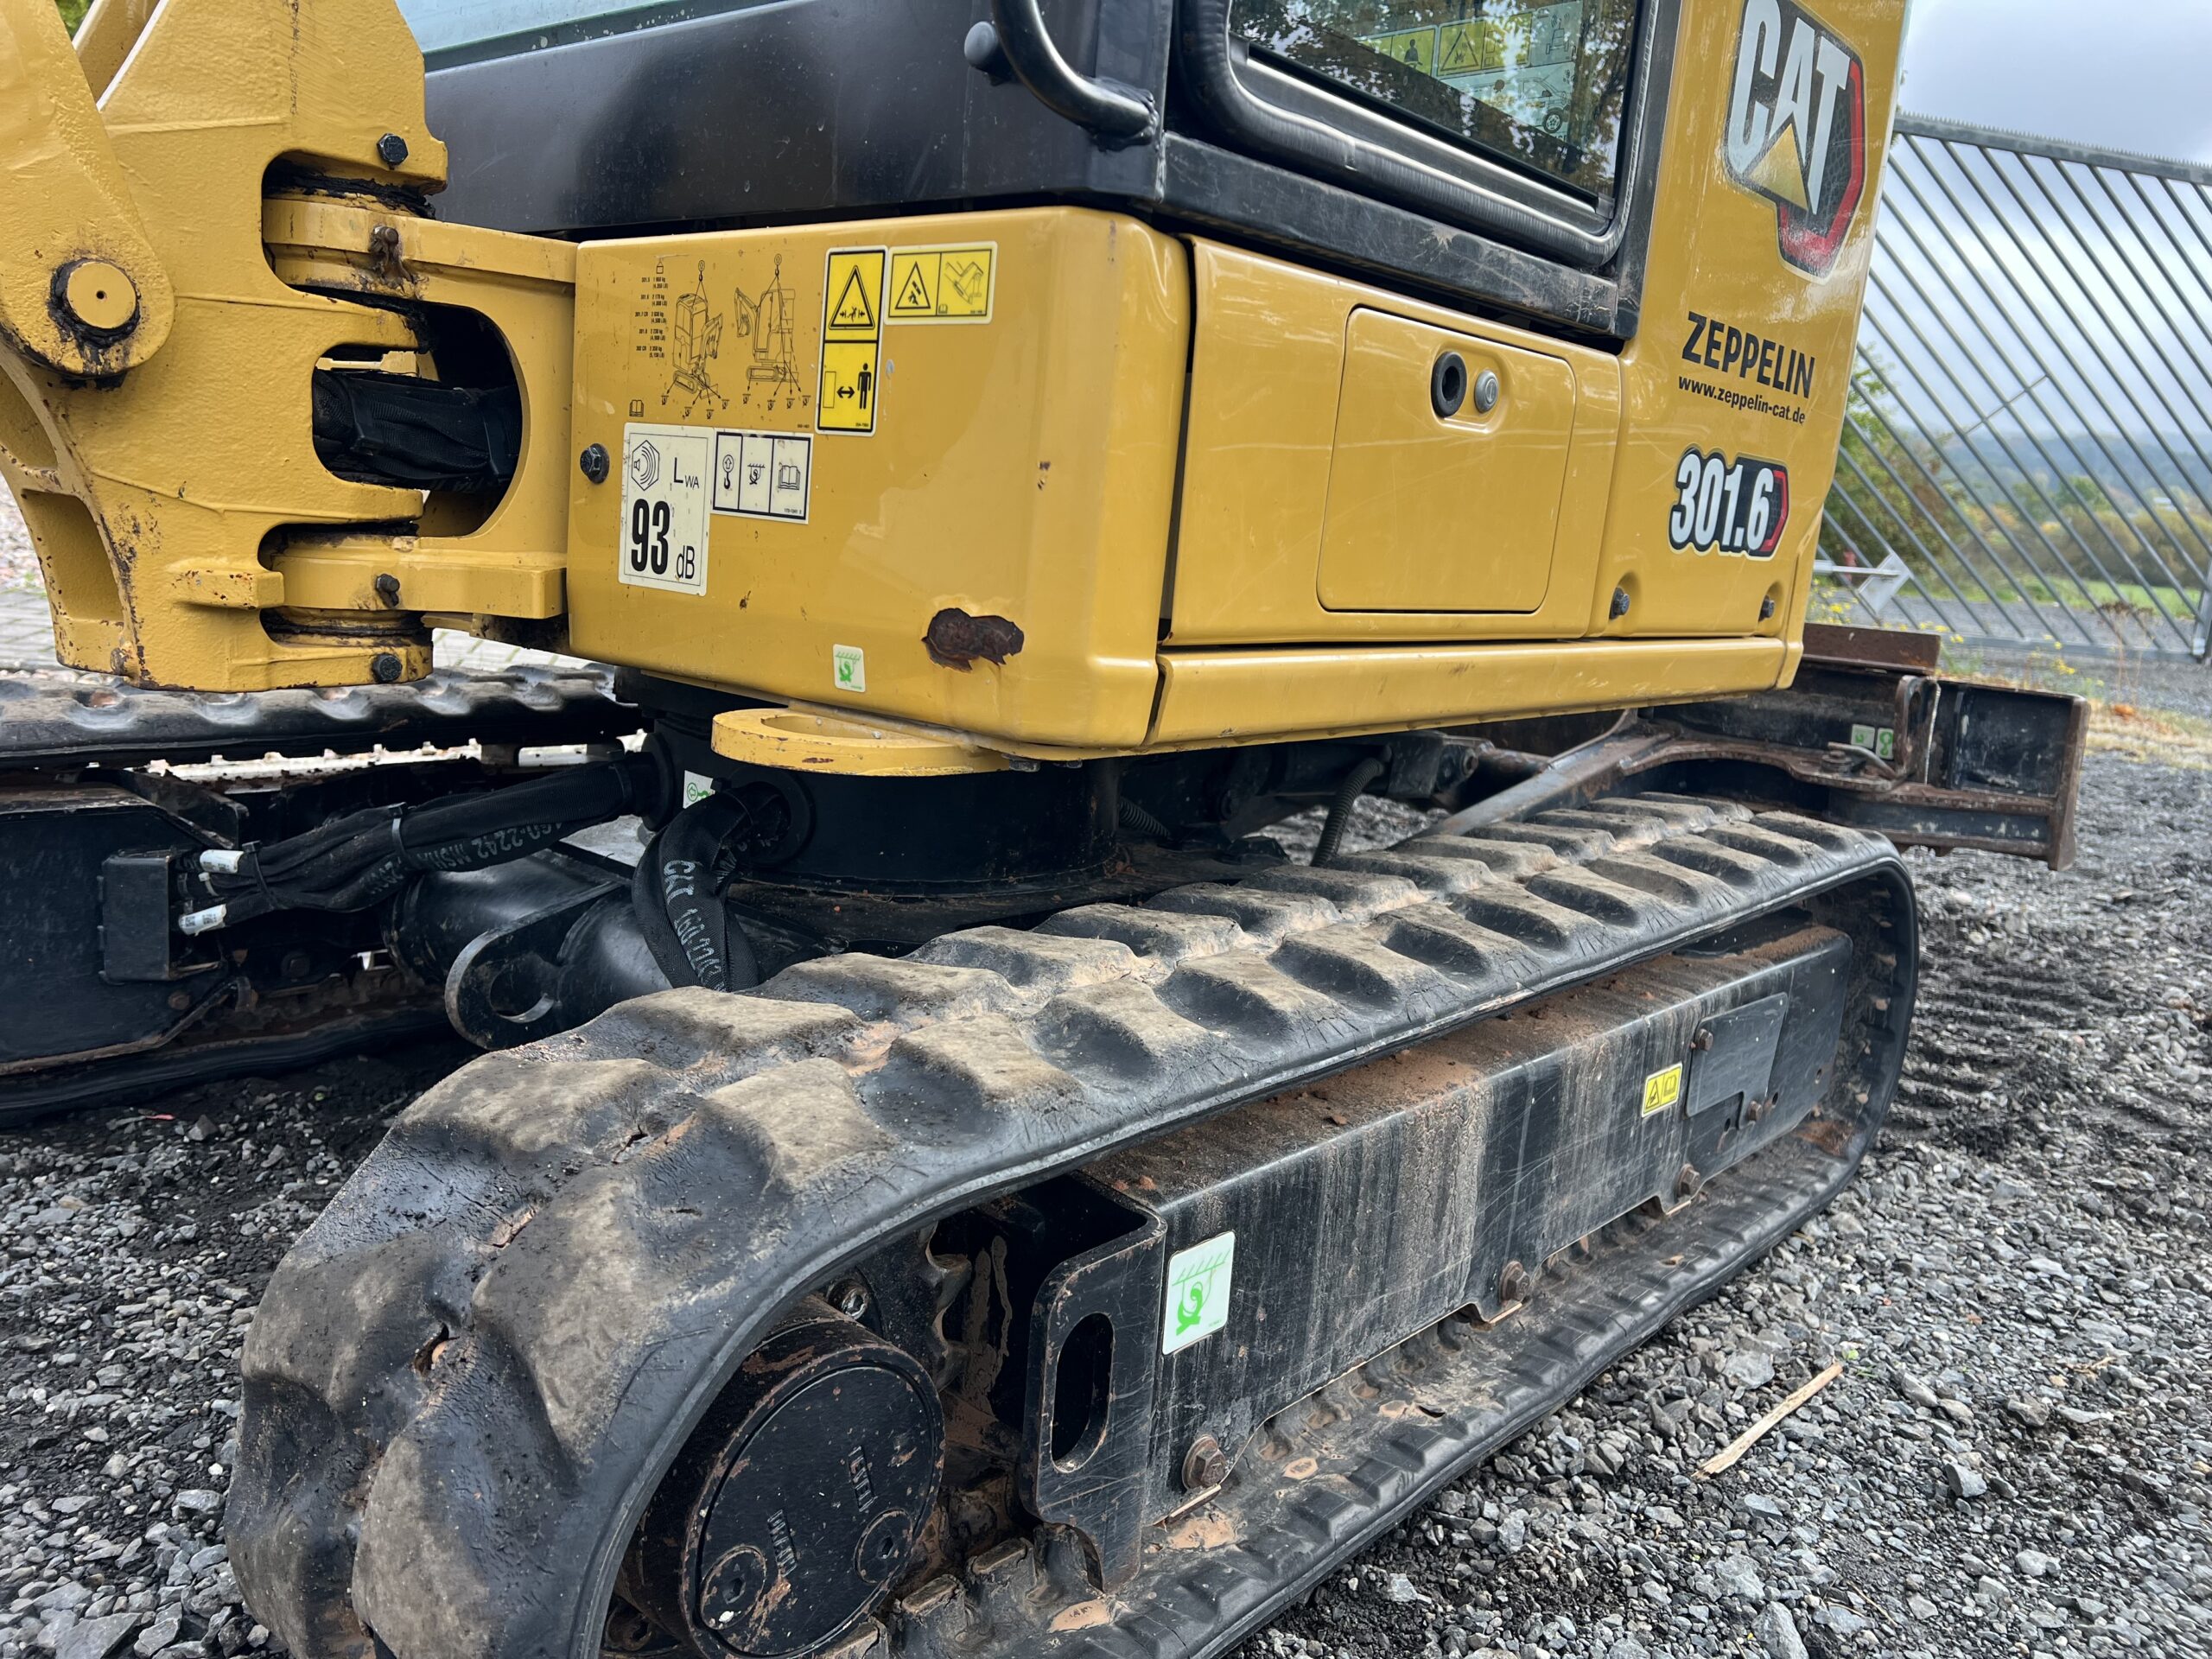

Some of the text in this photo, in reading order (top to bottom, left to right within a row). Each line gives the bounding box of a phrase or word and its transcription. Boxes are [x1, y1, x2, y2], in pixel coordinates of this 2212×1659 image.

[1728, 0, 1851, 215] CAT
[1681, 310, 1815, 399] ZEPPELIN
[1678, 376, 1806, 424] www.zeppelin-cat.de
[631, 498, 671, 576] 93
[1670, 453, 1775, 551] 301.6
[676, 545, 696, 580] dB
